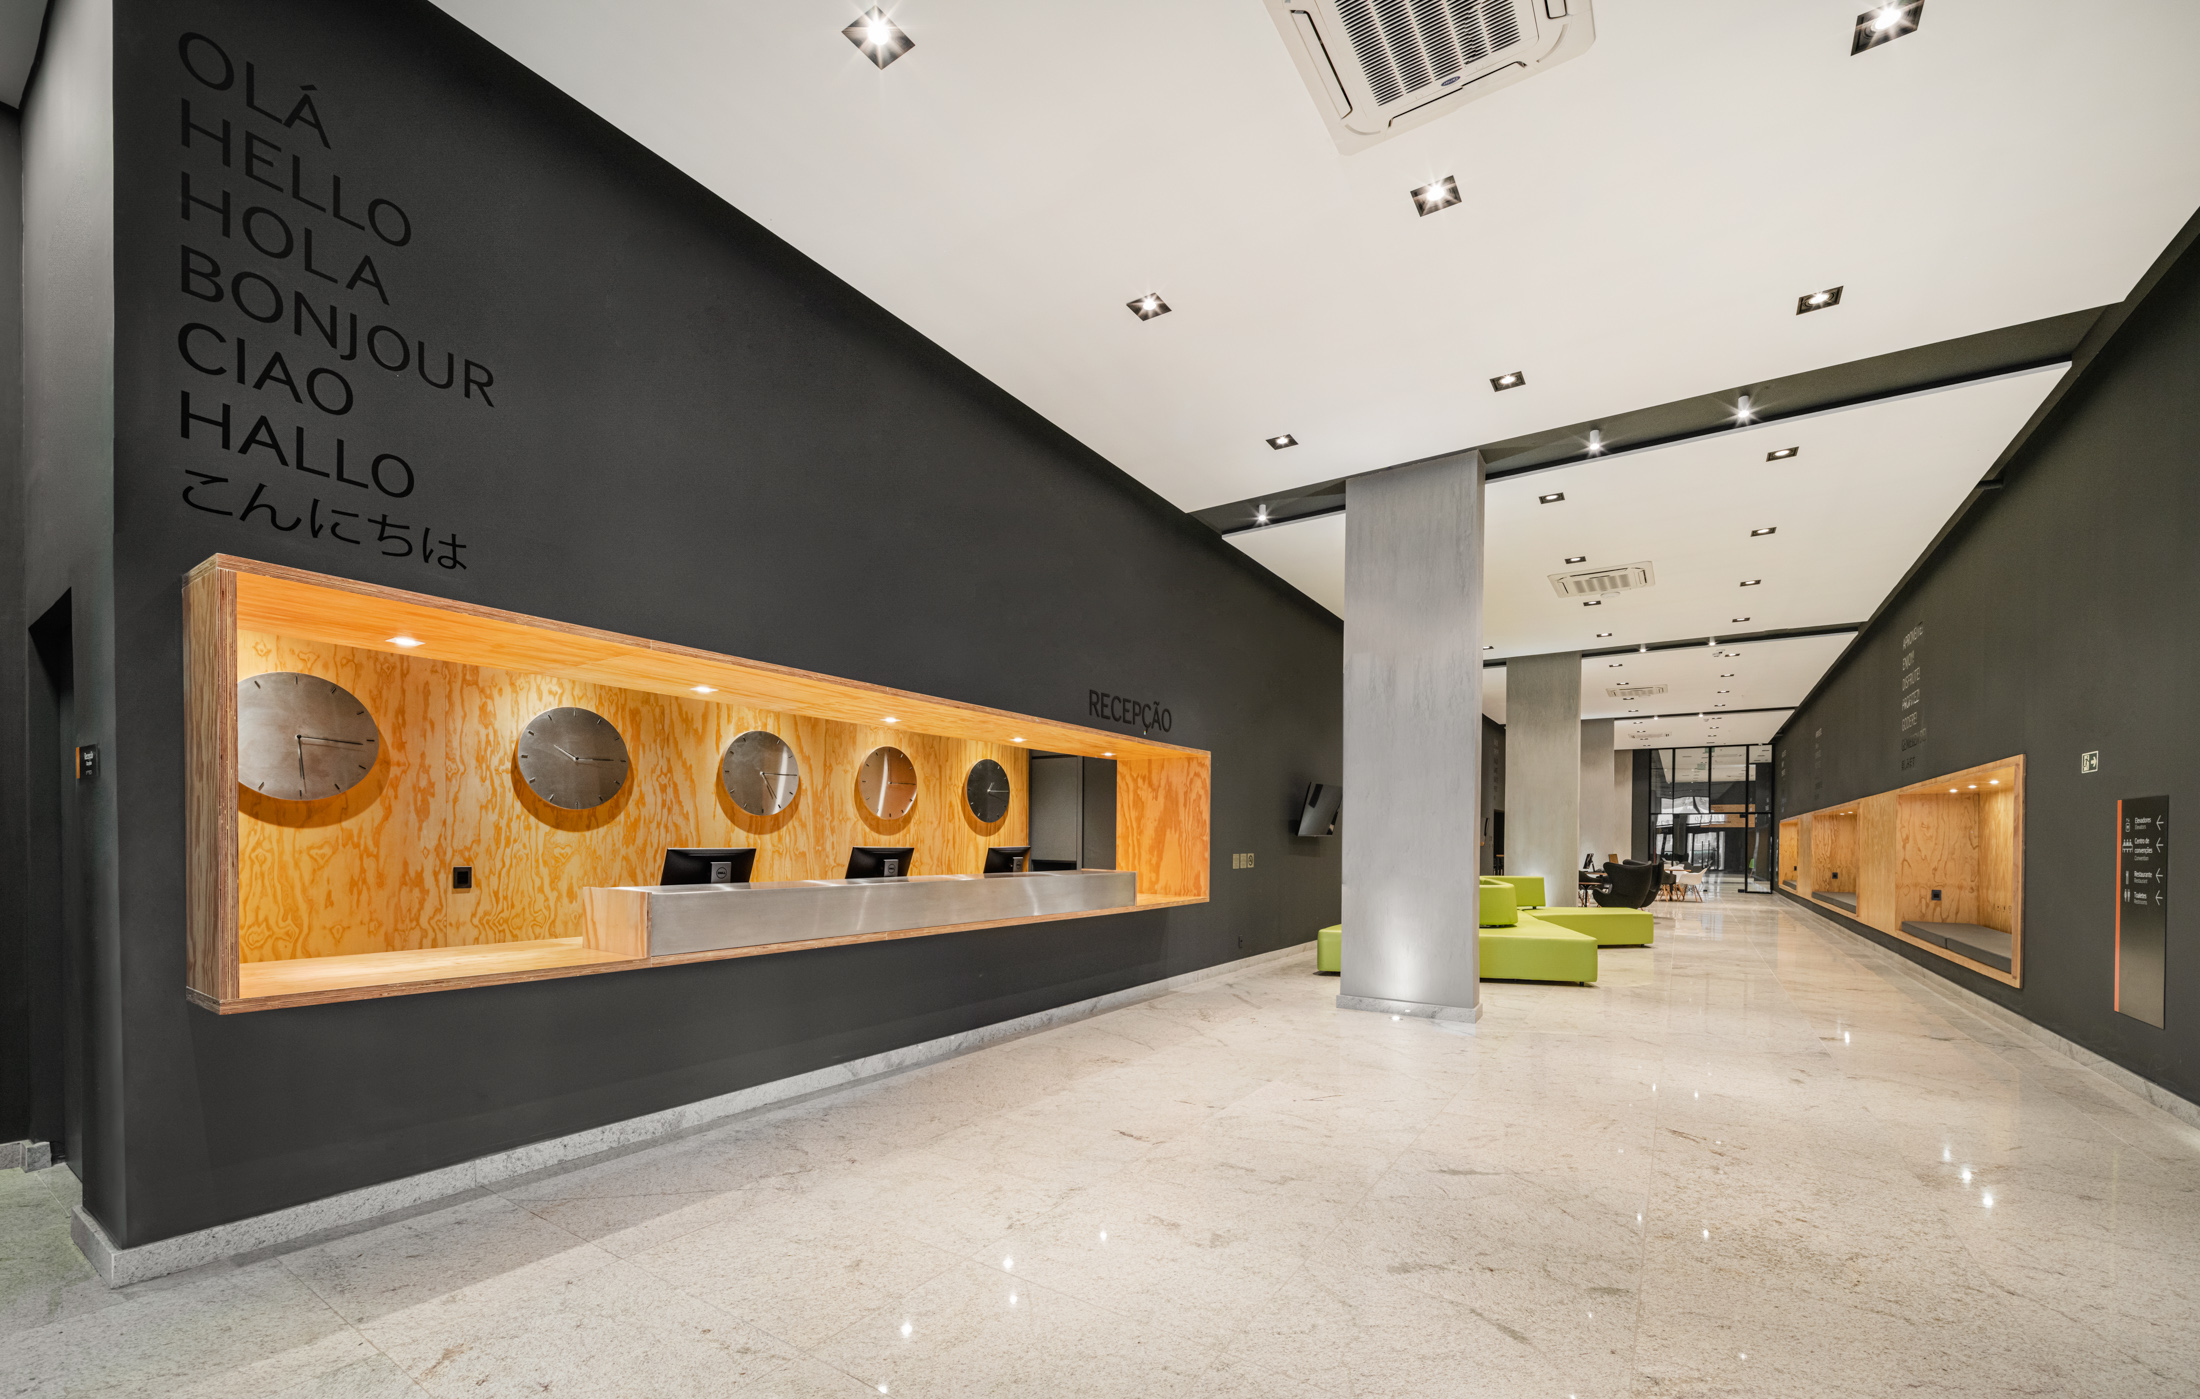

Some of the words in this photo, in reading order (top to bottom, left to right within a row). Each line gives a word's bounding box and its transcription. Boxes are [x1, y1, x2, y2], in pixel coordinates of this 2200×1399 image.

[178, 32, 331, 150] OLÁ
[181, 97, 412, 247] HELLO
[181, 171, 389, 306] HOLA
[177, 322, 354, 416] CIAO
[181, 244, 495, 407] BONJOUR
[180, 390, 415, 498] HALLO
[181, 469, 467, 571] こんにちは
[1088, 689, 1172, 734] RECEPÇÃO
